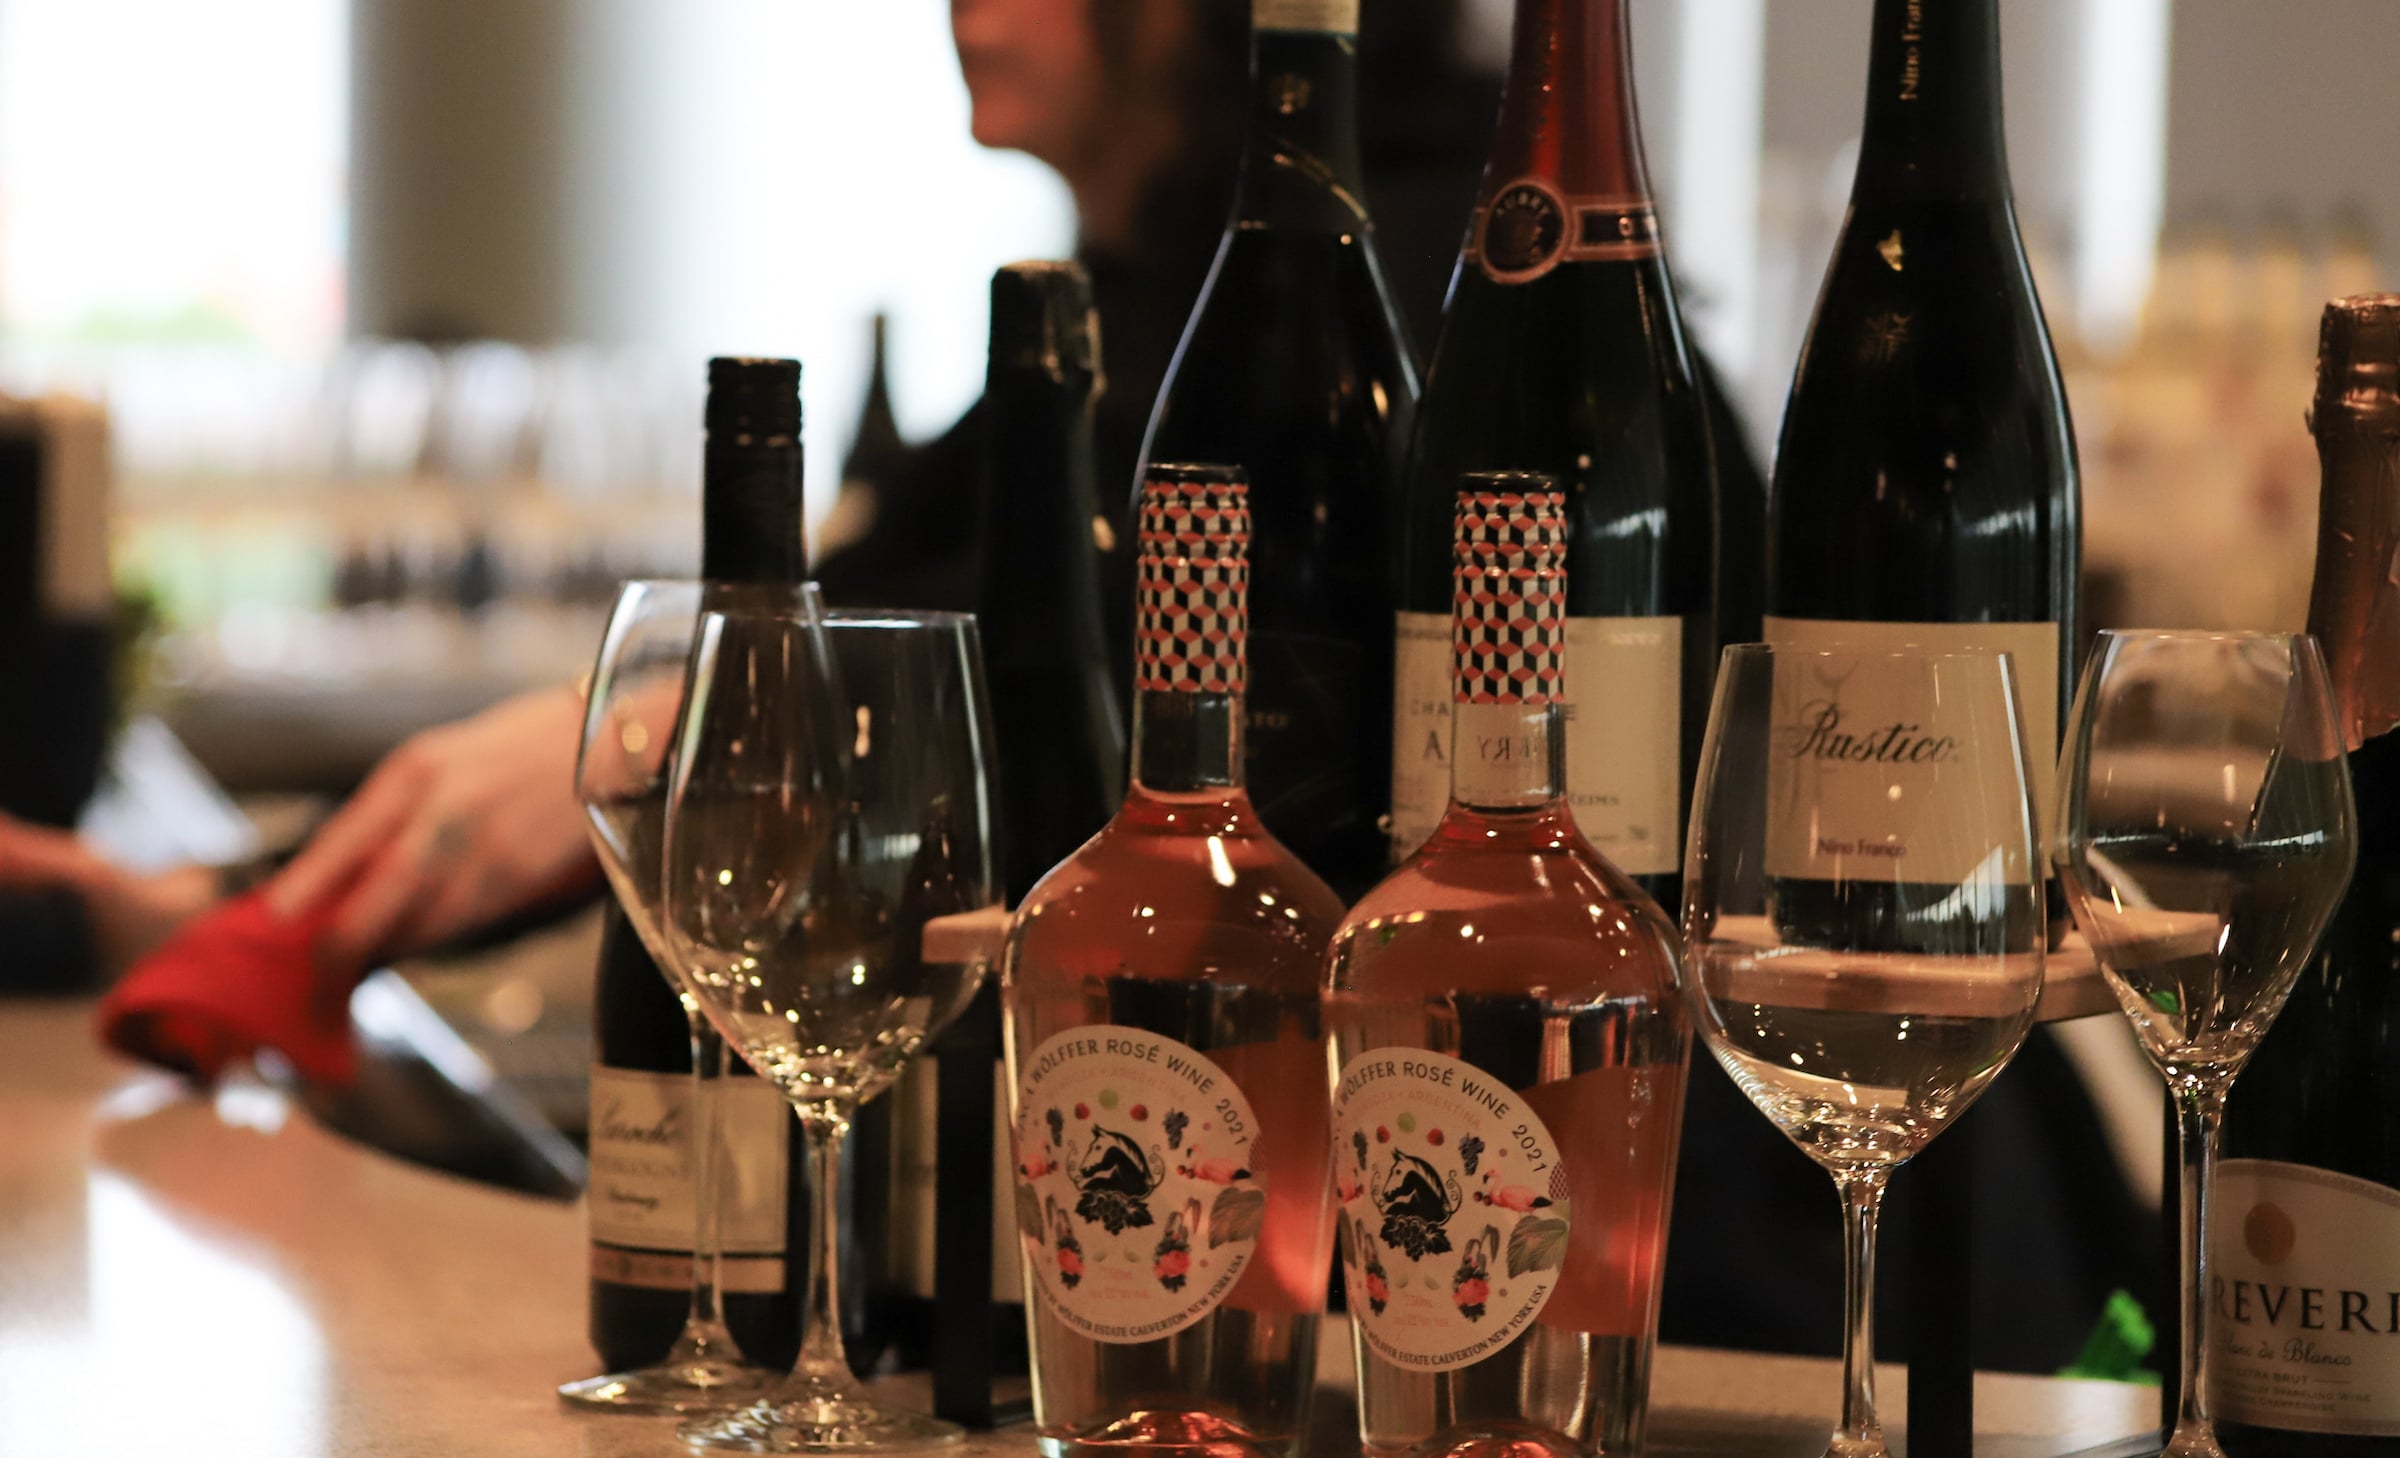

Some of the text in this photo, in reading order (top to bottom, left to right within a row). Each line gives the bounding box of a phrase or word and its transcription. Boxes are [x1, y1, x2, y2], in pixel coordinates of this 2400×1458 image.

[1792, 699, 1956, 763] Rustico
[1107, 1038, 1160, 1063] ROSÉ
[1166, 1054, 1215, 1095] WINE
[1215, 1098, 1249, 1146] 2021
[1403, 1061, 1455, 1086] ROSÉ
[1461, 1078, 1511, 1120] WINE
[1511, 1124, 1548, 1173] 2021
[1129, 1312, 1188, 1337] CALVERTON
[1398, 1350, 1431, 1366] ESTATE
[1431, 1342, 1488, 1366] CALVERTON
[1487, 1328, 1511, 1347] NEW
[1508, 1304, 1534, 1329] YORK
[1529, 1284, 1547, 1305] USA
[2283, 1337, 2352, 1366] Blancs
[2272, 1372, 2309, 1385] BRUT
